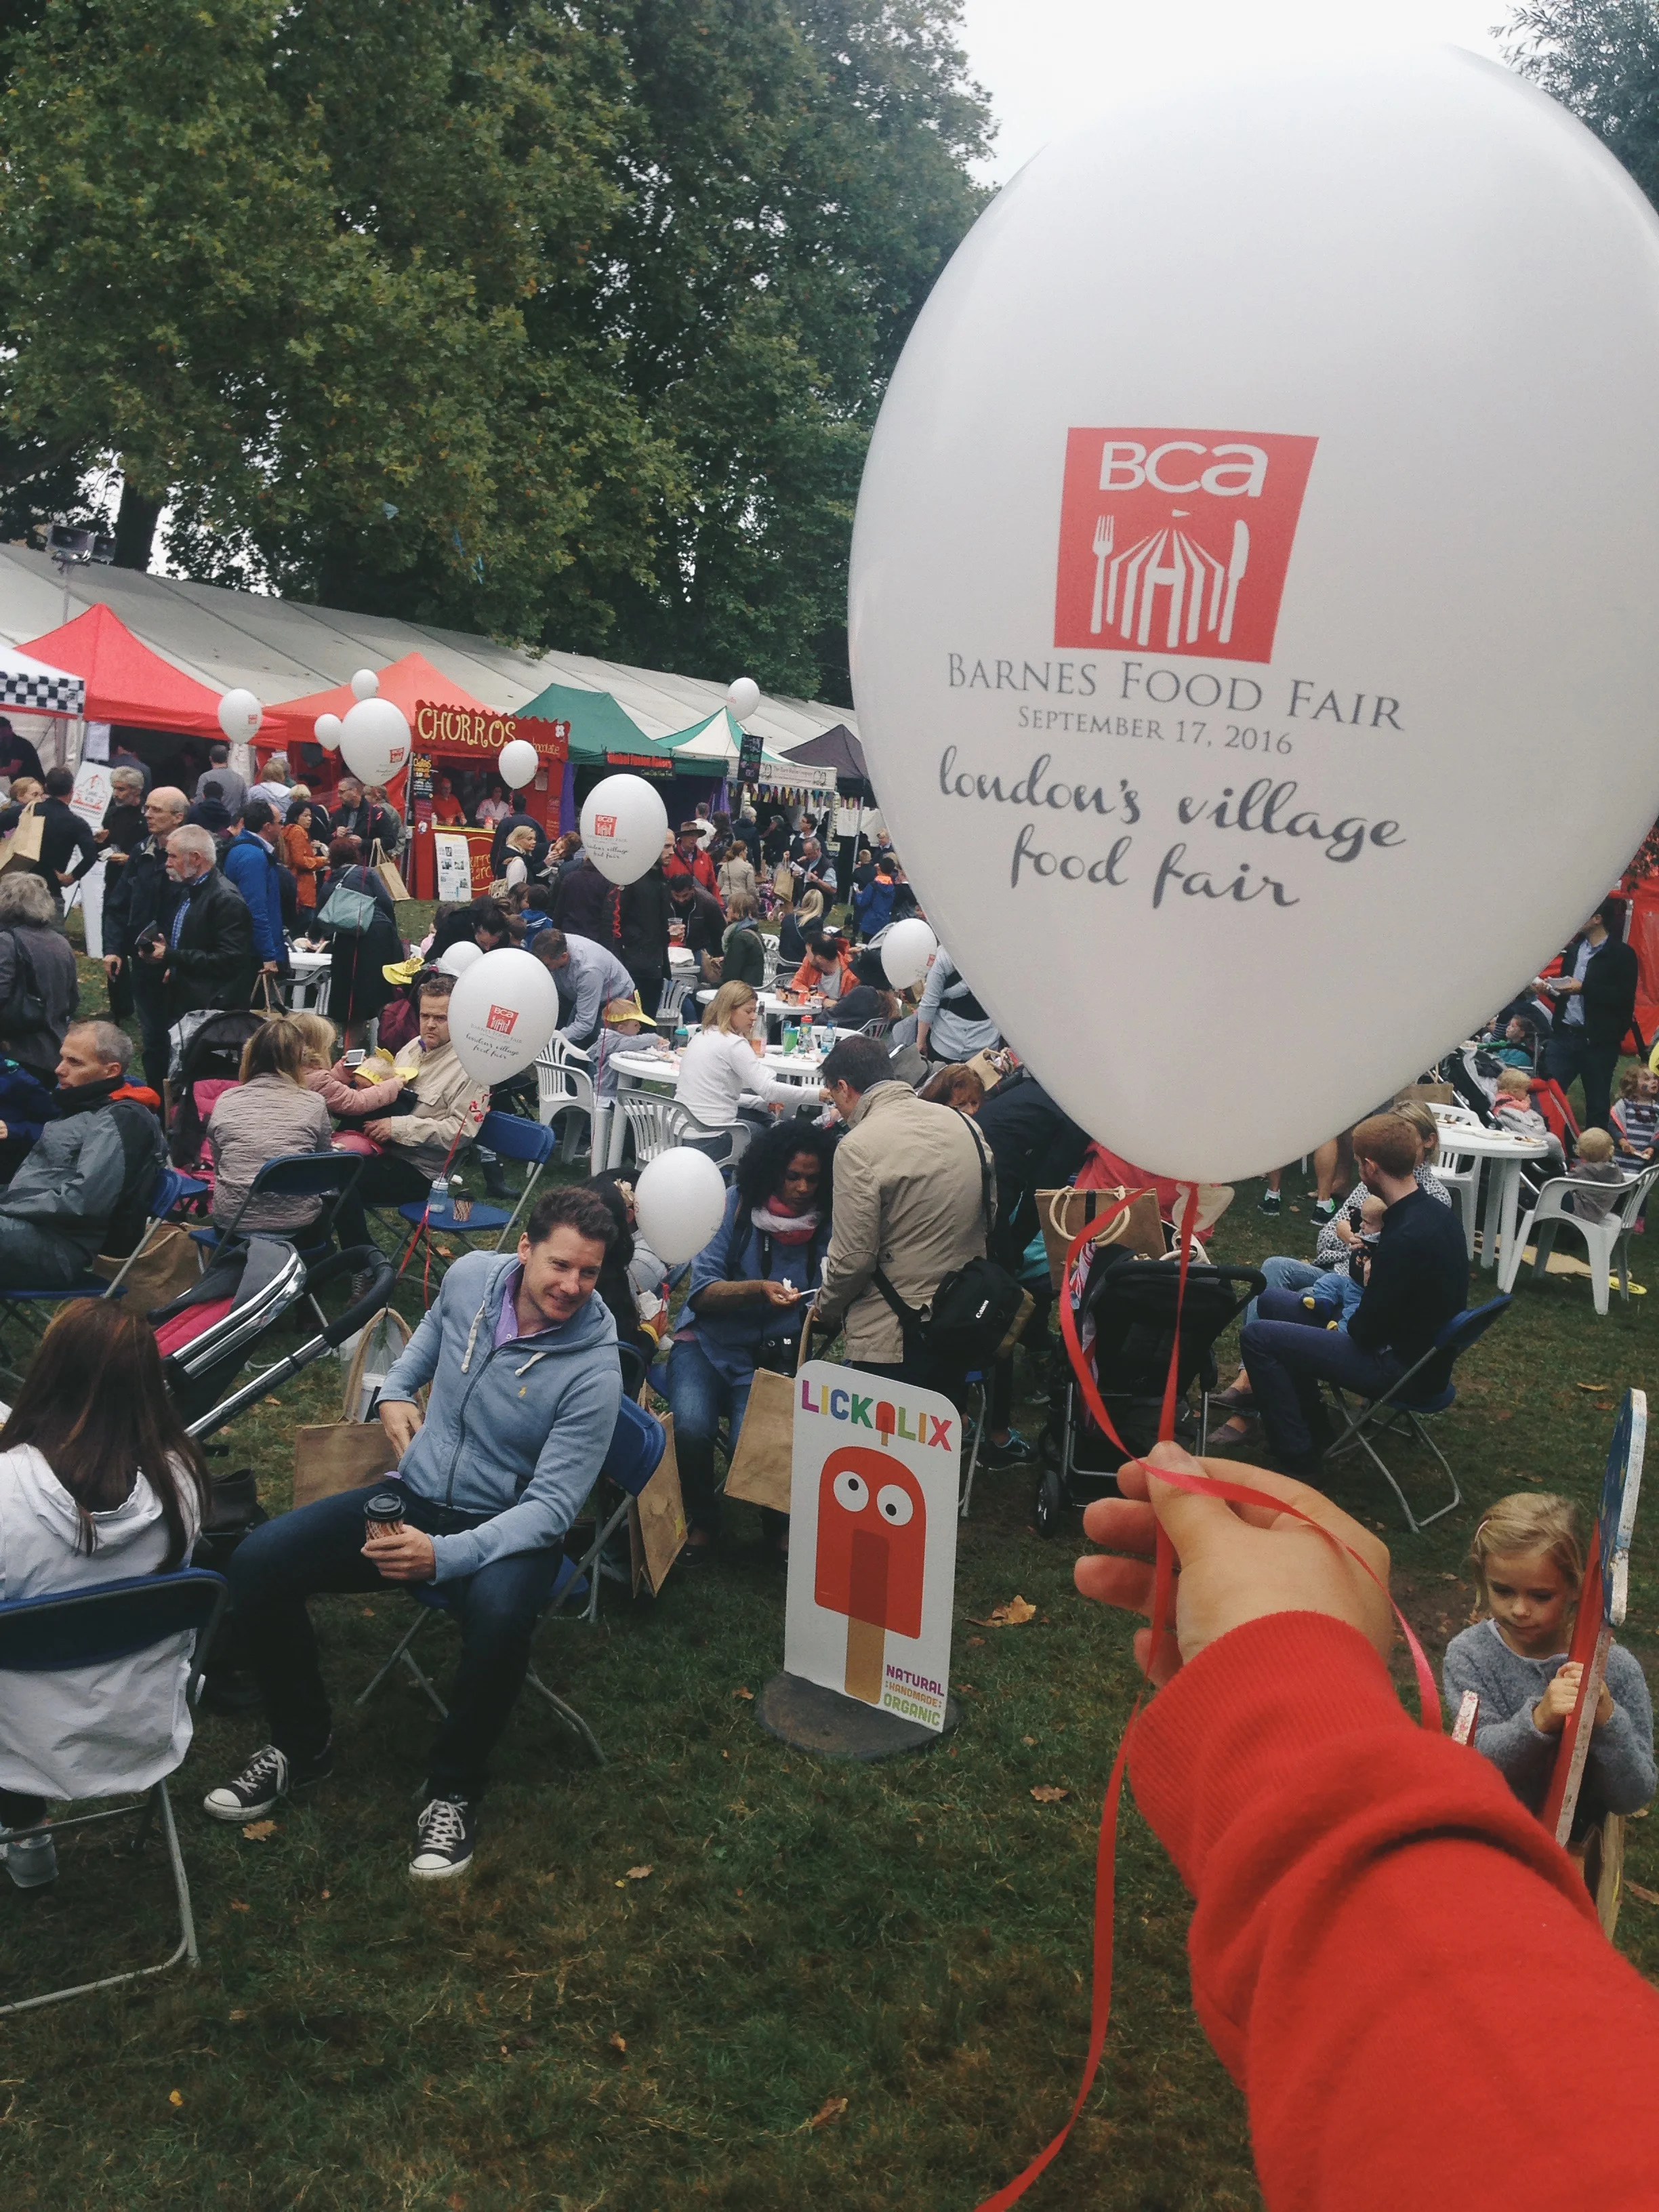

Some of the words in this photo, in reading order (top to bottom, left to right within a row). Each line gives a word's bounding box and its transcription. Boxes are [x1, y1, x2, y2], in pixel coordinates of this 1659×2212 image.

[947, 652, 1097, 697] BARNES
[1120, 660, 1263, 712] FOOD
[1287, 678, 1405, 731] FAIR
[417, 708, 516, 748] CHURROS
[1017, 705, 1165, 741] SEPTEMBER
[1176, 720, 1212, 747] 17,
[1224, 724, 1293, 755] 2016
[939, 745, 1143, 825] london's
[1178, 777, 1408, 863] village
[1010, 823, 1133, 889] food
[1151, 842, 1300, 909] fair
[975, 1299, 989, 1319] Canon
[886, 1664, 945, 1698] NATURAL
[883, 1693, 941, 1726] ORGANIC
